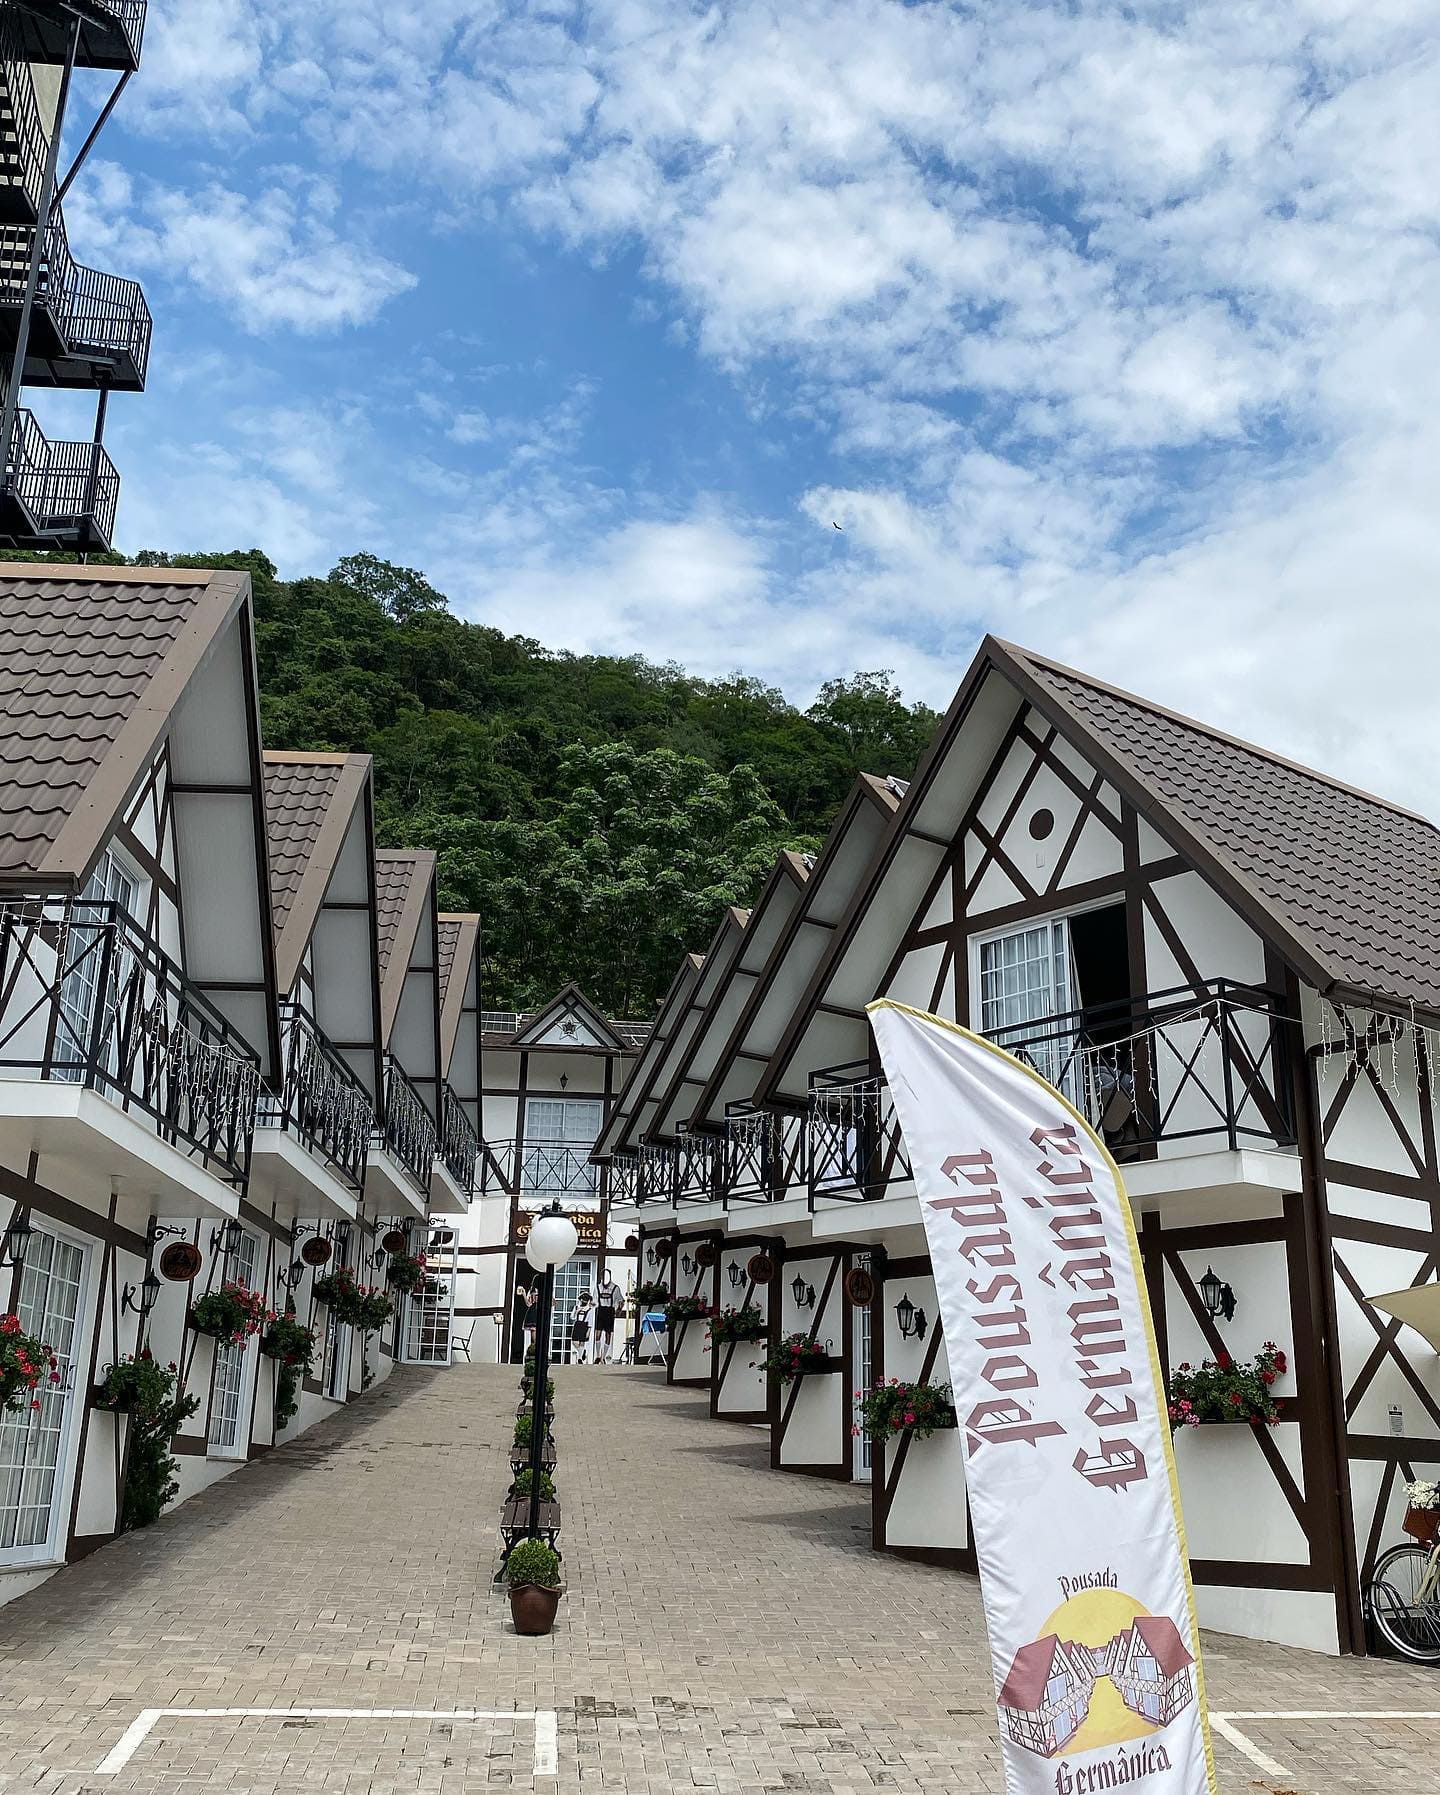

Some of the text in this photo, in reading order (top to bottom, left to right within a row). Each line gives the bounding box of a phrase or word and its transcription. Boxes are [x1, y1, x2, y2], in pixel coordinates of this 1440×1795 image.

[927, 1149, 1067, 1458] Pousada
[1023, 1123, 1148, 1493] Germânica
[1057, 1567, 1119, 1601] Pousada
[1055, 1741, 1172, 1795] Germânica
